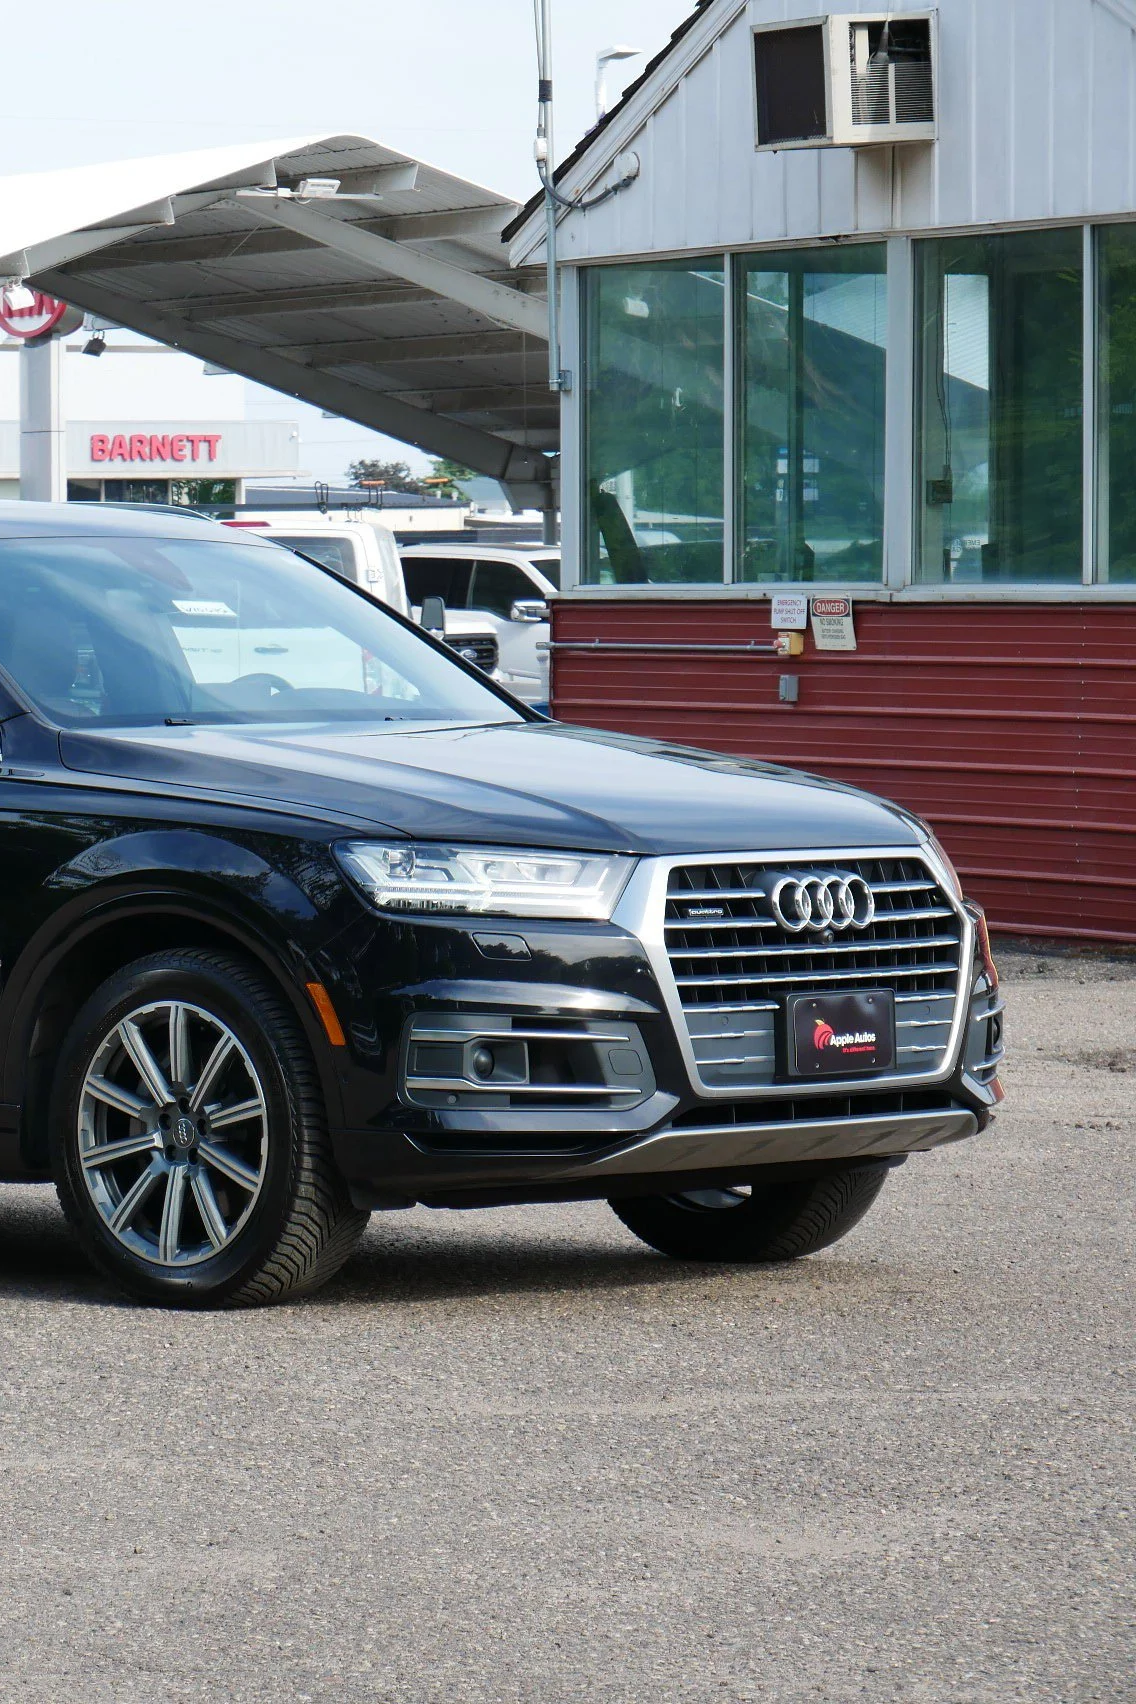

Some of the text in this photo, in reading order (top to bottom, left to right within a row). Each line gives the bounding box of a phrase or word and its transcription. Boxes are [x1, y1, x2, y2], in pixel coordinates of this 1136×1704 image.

[90, 435, 222, 461] BARNETT
[816, 602, 845, 612] DANGER
[830, 1032, 876, 1047] Apple Autos
